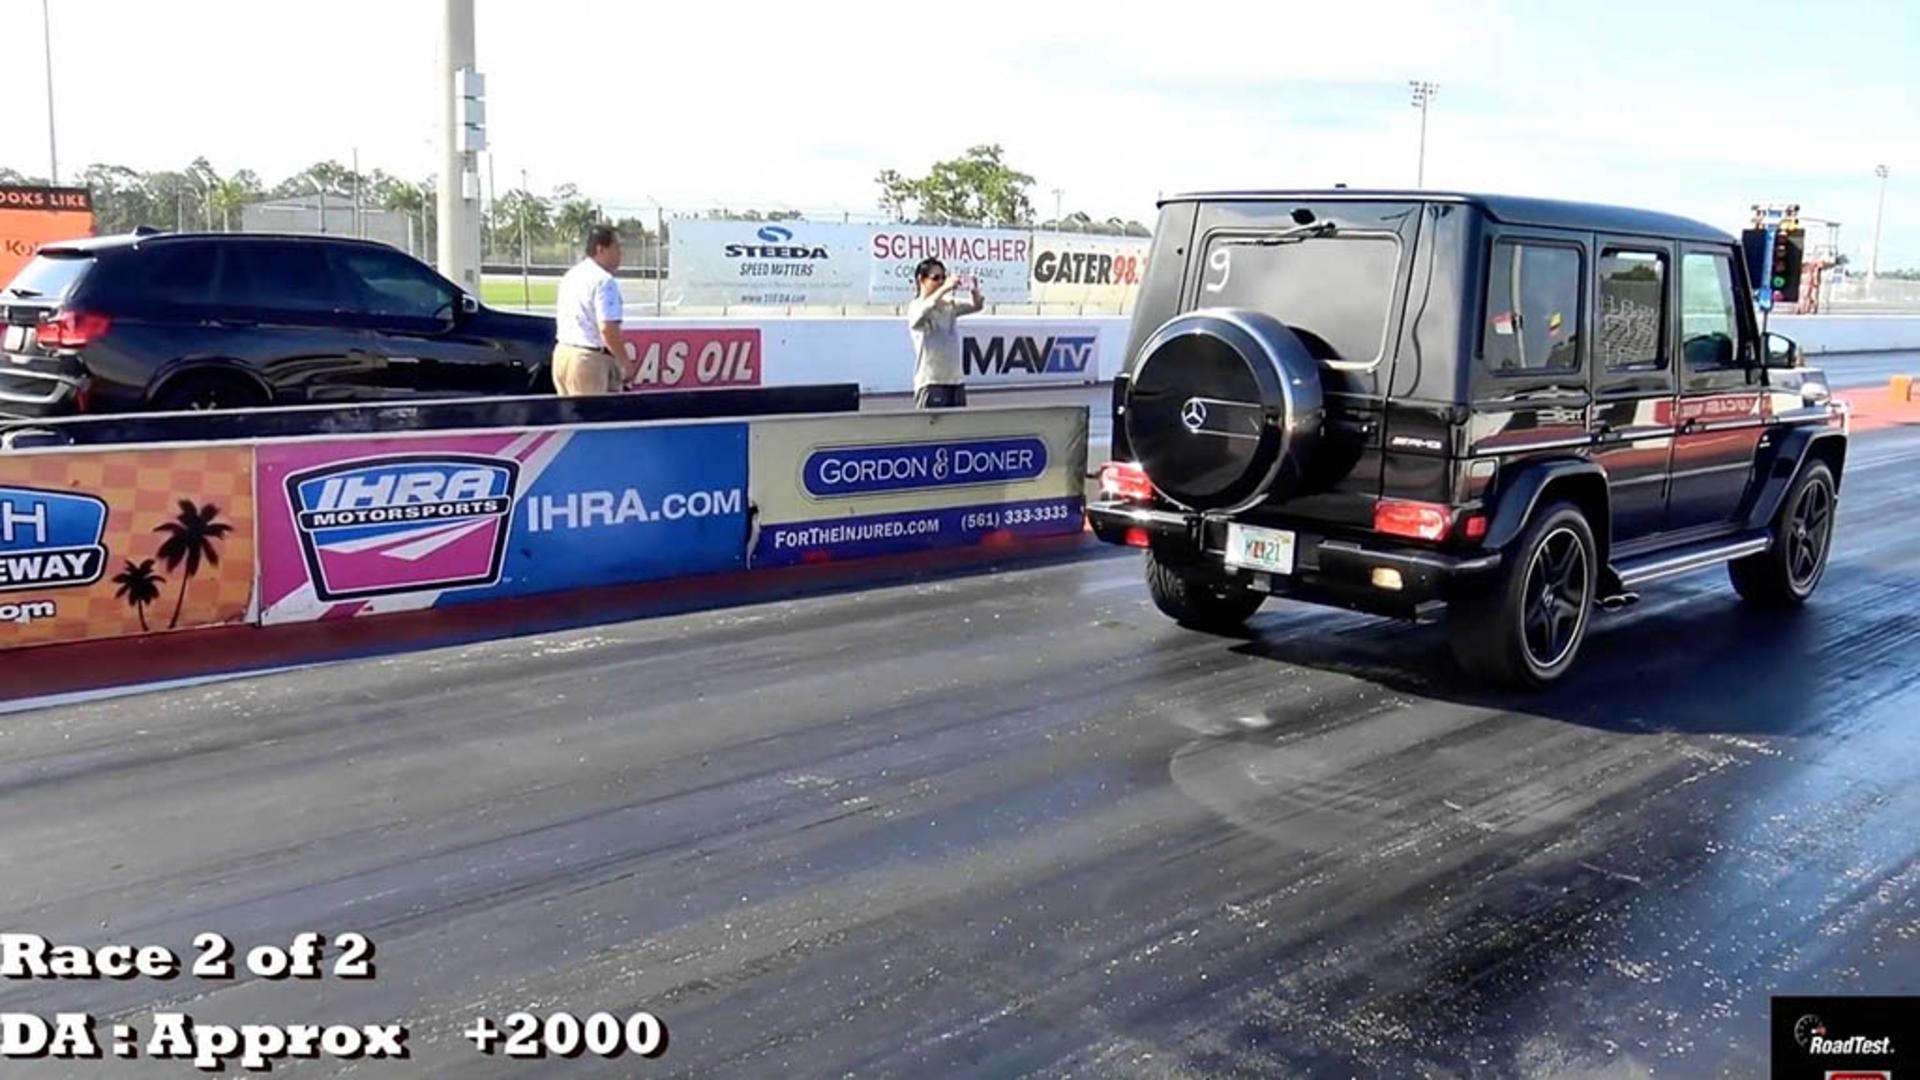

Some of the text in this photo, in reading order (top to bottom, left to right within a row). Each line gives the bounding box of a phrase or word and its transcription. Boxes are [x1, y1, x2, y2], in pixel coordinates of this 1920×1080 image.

[50, 194, 86, 207] LIKE
[725, 244, 828, 259] STEEDA
[873, 235, 1026, 263] SCHUMACHER
[740, 262, 814, 277] SPEED MATTERS
[1206, 247, 1230, 292] 9
[697, 341, 752, 383] OIL
[820, 448, 1034, 484] GORDON & DONER
[317, 470, 495, 511] IHRA
[313, 500, 498, 526] MOTORSPORTS
[527, 488, 741, 532] IHRA.COM
[961, 512, 1000, 532] (561)
[1004, 505, 1068, 525] 333-3333
